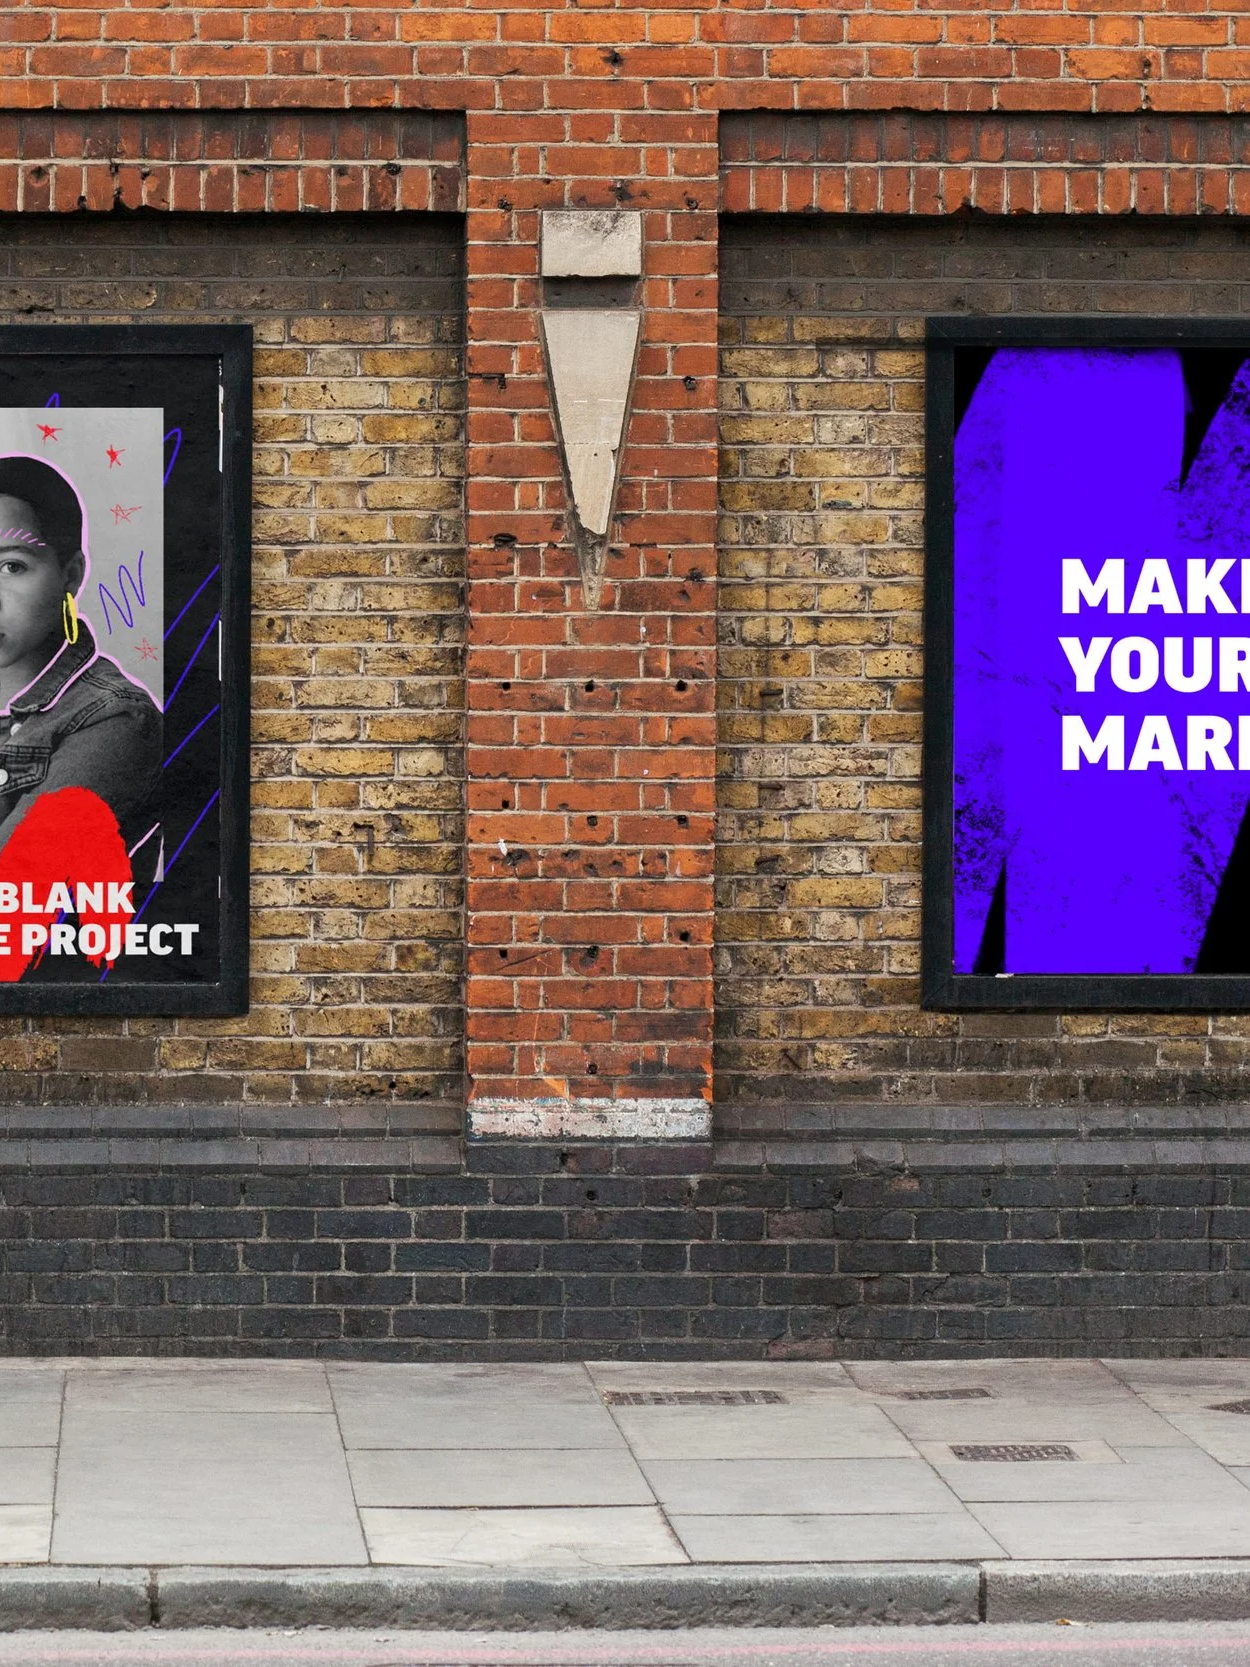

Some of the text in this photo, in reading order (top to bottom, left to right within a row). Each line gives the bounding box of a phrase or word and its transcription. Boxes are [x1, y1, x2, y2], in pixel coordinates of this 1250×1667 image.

[1062, 558, 1250, 614] MAK
[1058, 636, 1250, 693] YOUR
[1062, 715, 1250, 770] MAR
[22, 923, 199, 961] PROJECT
